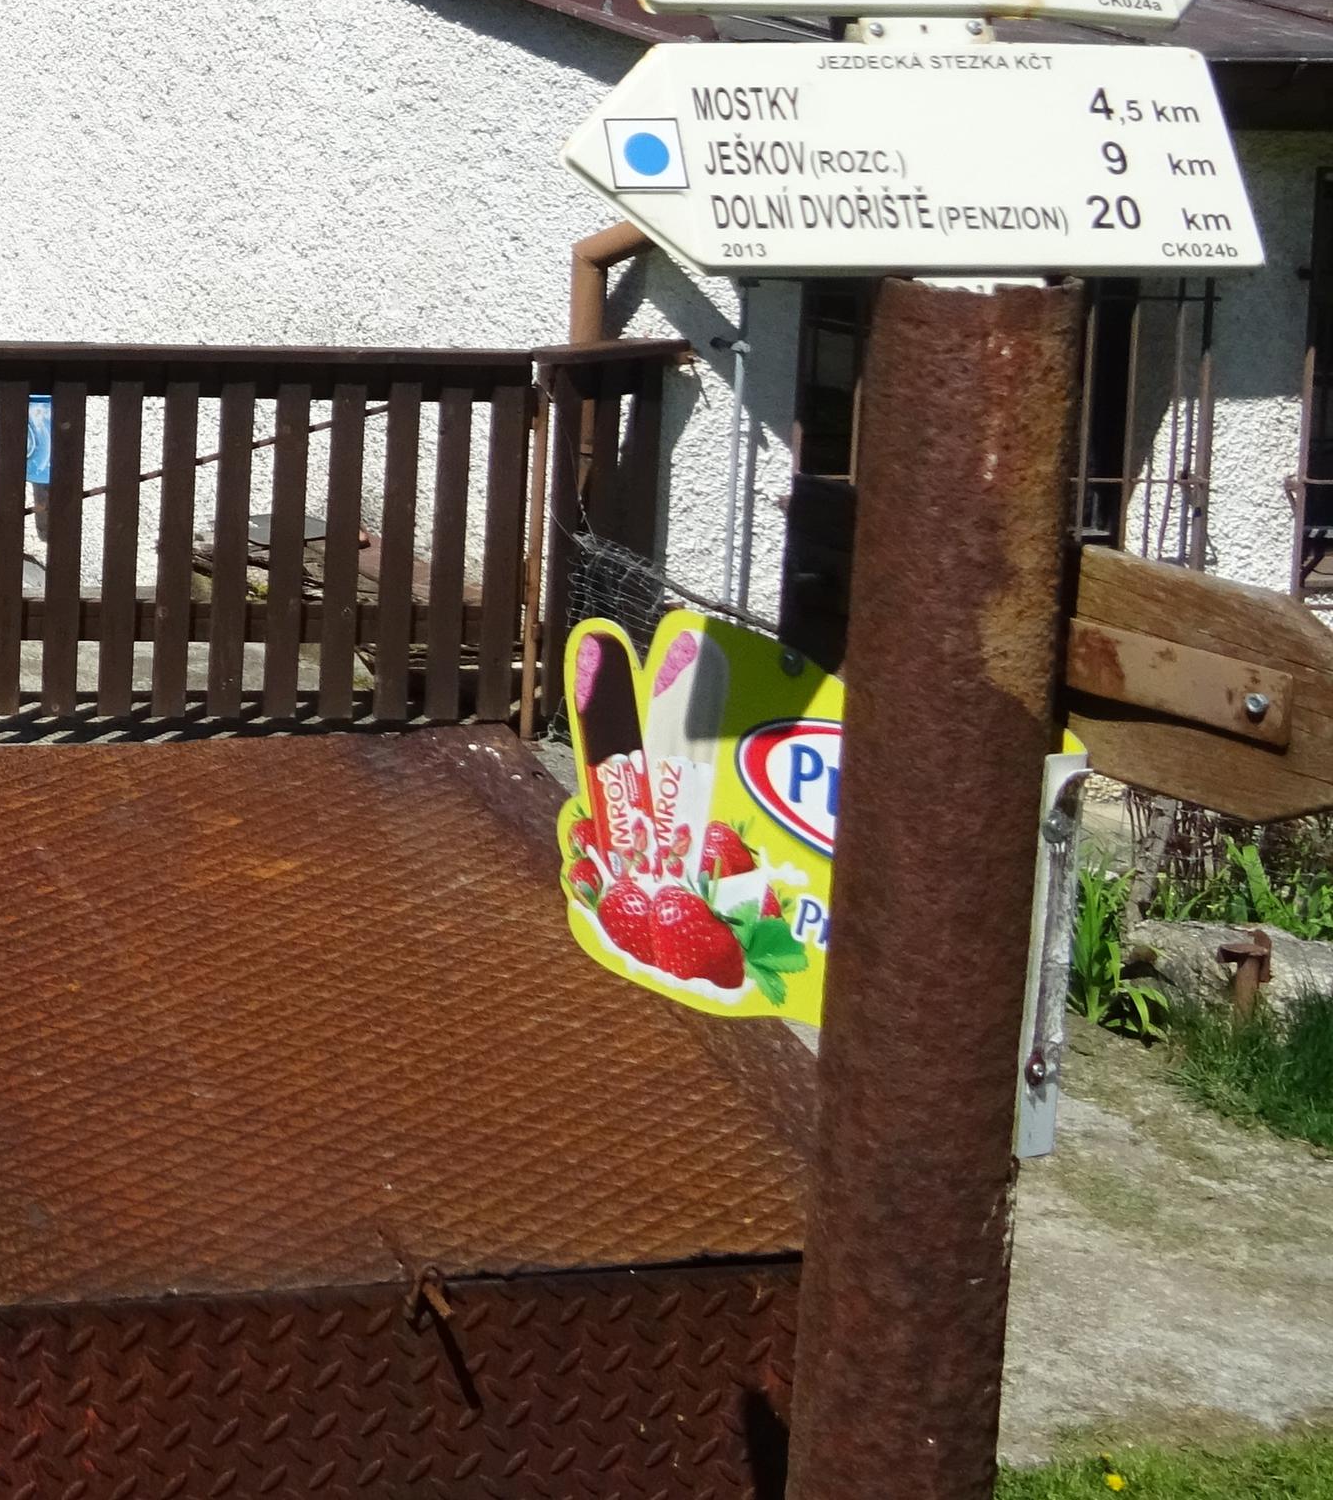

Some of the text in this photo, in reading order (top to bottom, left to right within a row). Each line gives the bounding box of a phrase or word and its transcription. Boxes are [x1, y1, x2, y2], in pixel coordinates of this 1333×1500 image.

[816, 52, 1053, 70] JEZDECKÁ STEZKA KČT
[691, 86, 1200, 125] MOSTKY 4,5 km
[704, 132, 1217, 179] JEŠKOV (ROZC.) 9 km
[710, 185, 1231, 236] DOLNÍ DVOŘIŠTĚ (PENZION) 20 km
[721, 243, 767, 258] 2013
[1161, 243, 1239, 258] CK024b
